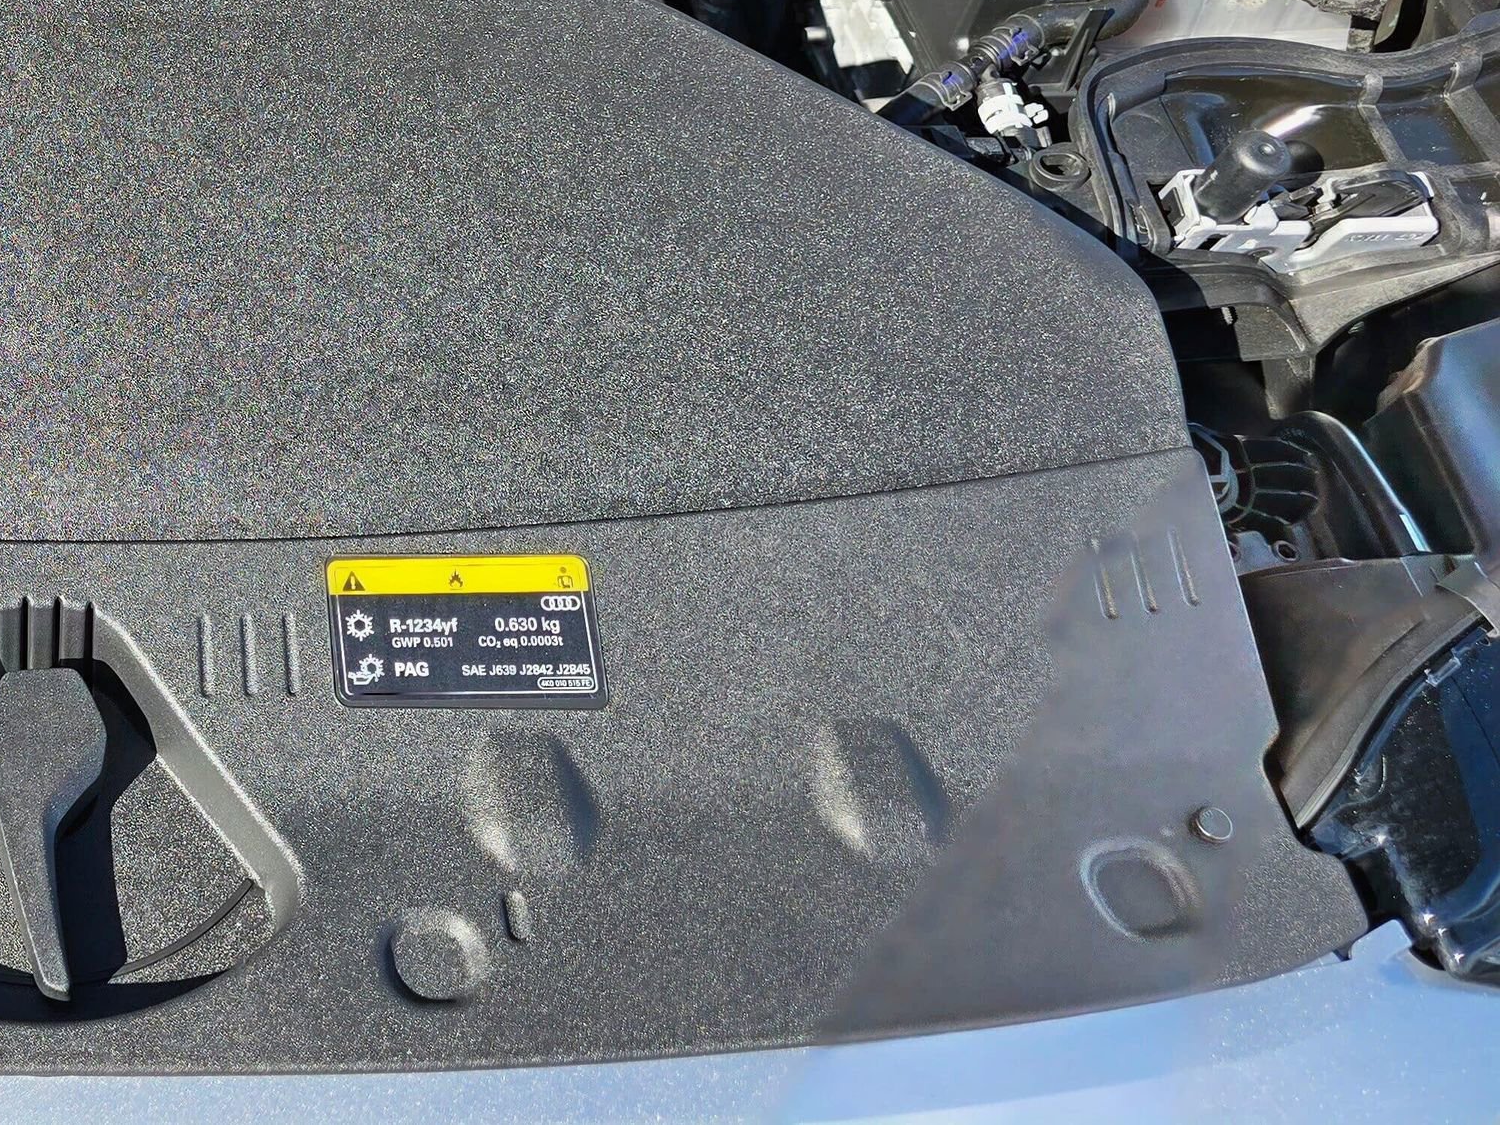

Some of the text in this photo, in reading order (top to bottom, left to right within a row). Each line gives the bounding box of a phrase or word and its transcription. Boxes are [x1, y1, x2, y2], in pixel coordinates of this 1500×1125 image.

[389, 618, 458, 635] R-1234yf
[494, 617, 561, 634] 0.630 kg
[391, 636, 454, 648] GWP 0.501
[519, 635, 564, 648] 0.0003t
[393, 662, 430, 677] PAG
[461, 663, 591, 676] SAE J639 J2842 J2845
